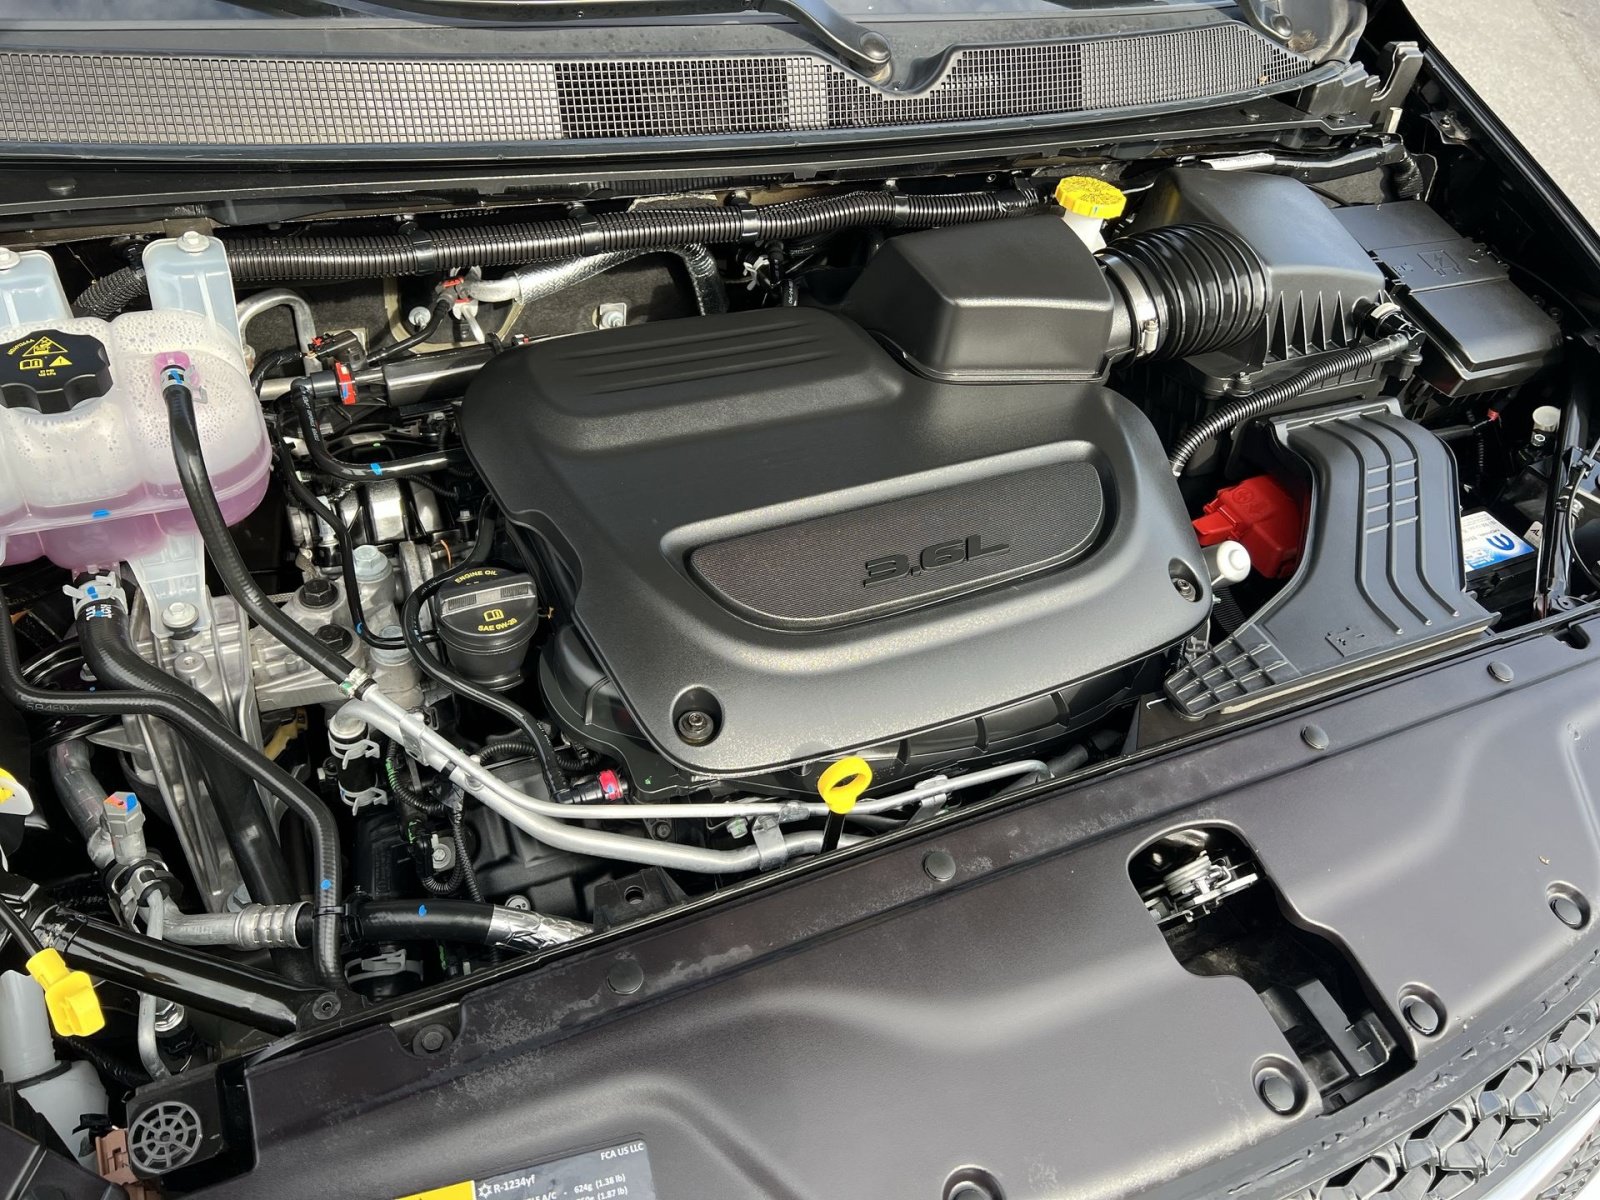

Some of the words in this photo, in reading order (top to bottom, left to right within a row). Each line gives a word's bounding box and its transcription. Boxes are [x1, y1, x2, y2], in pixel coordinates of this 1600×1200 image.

[862, 533, 1010, 588] 3.6L
[454, 570, 484, 584] ENGINE
[477, 624, 495, 632] SAE
[600, 1149, 617, 1161] FCA
[617, 1146, 629, 1156] US
[629, 1142, 645, 1153] LLC
[493, 1174, 536, 1194] R-1234yf
[573, 1183, 593, 1194] 624g
[595, 1176, 615, 1190] (1.38
[614, 1173, 626, 1183] lb)
[597, 1189, 616, 1200] (1.87
[616, 1185, 628, 1196] lb)
